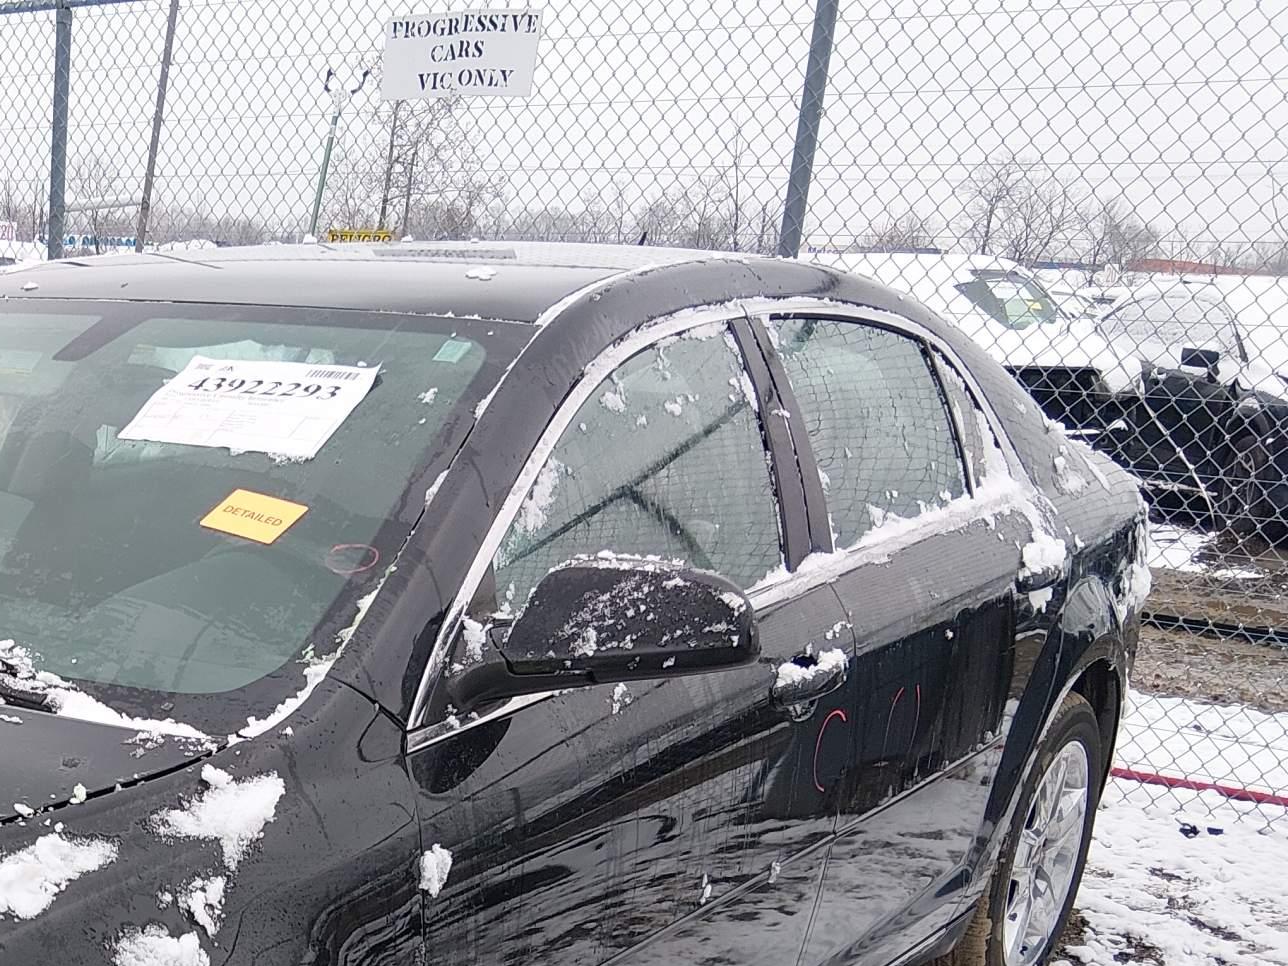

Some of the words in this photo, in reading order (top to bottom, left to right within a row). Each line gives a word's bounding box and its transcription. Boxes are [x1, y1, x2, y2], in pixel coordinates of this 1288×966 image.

[391, 14, 539, 38] PROGRESSIVE
[430, 39, 485, 62] CARS
[418, 72, 452, 90] VIC
[457, 69, 514, 88] ONLY
[188, 377, 342, 400] 43922293
[222, 504, 284, 528] DETAILED
